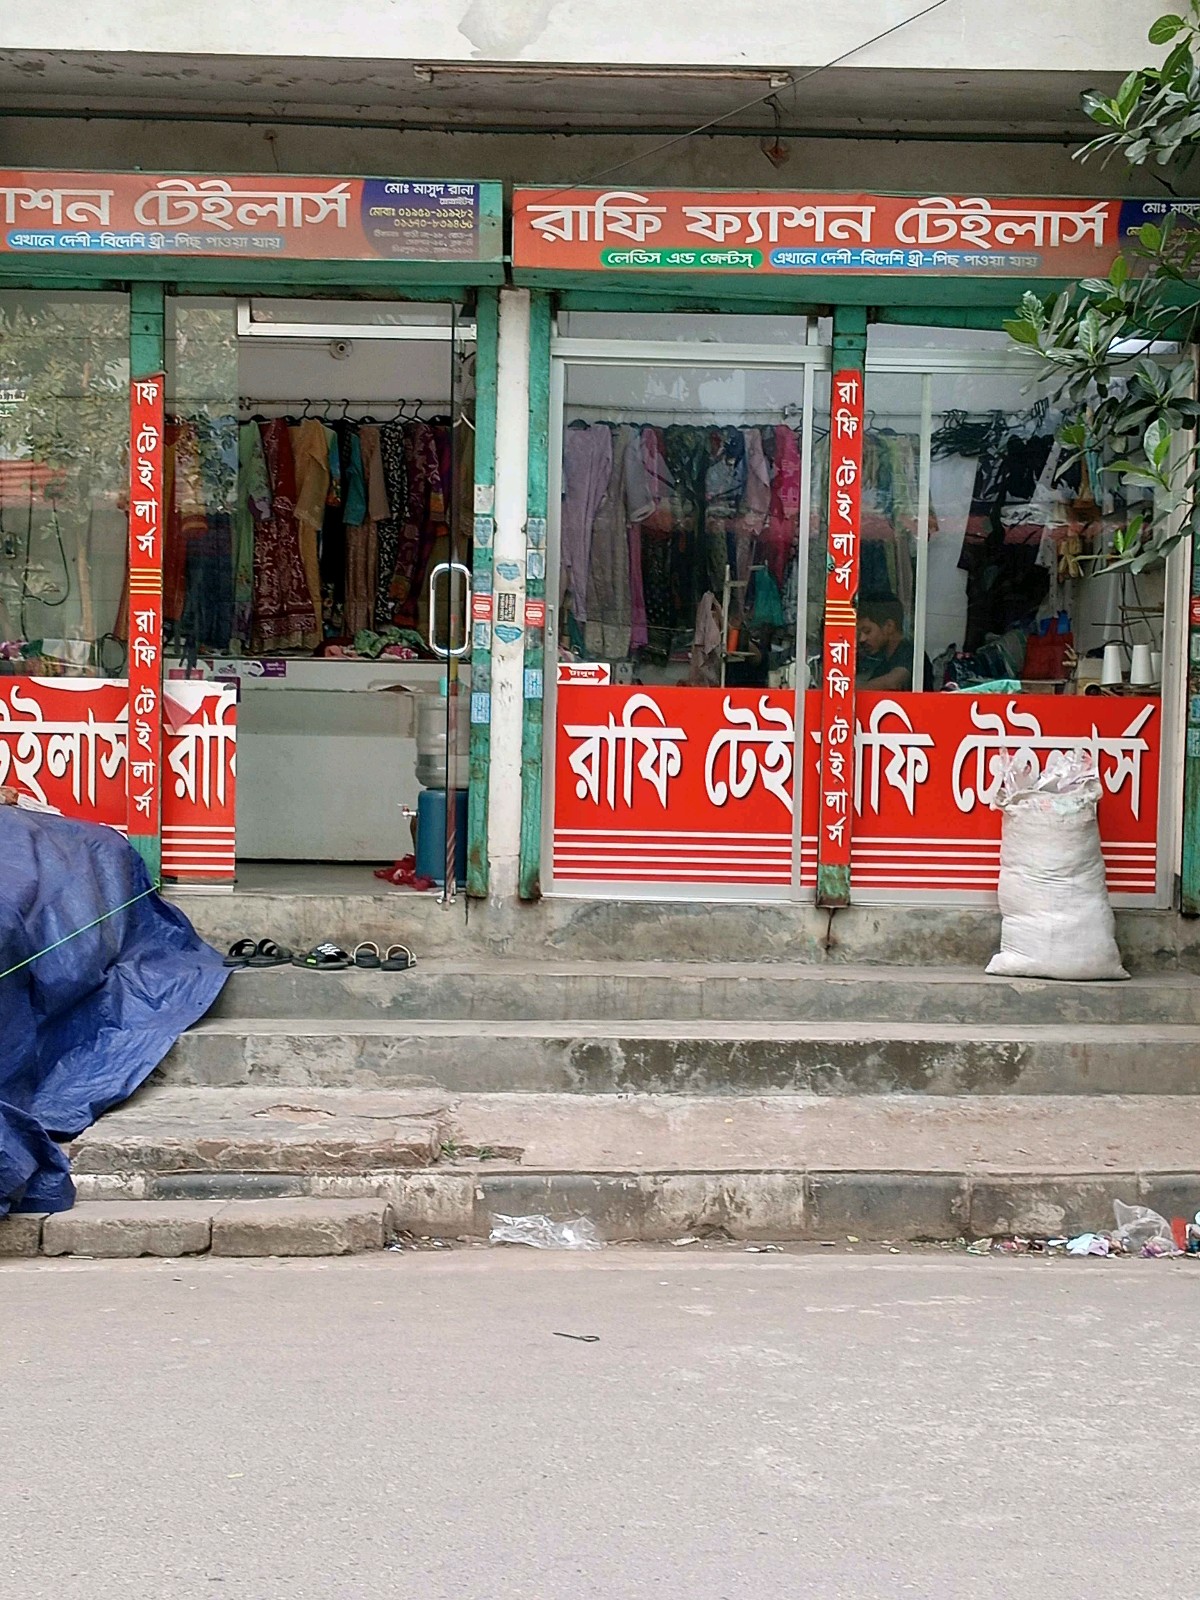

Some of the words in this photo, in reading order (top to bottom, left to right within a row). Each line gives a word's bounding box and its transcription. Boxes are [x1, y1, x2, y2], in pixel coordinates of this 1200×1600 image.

[384, 183, 410, 195] মোঃ
[413, 183, 445, 198] মাসুদ
[447, 184, 475, 196] রানা
[133, 178, 351, 231] টেইলার্স
[1142, 202, 1167, 213] মোঃ
[526, 191, 667, 242] রাফি
[682, 205, 876, 243] ফ্যাশন
[894, 196, 1110, 249] টেইলার্স
[11, 233, 55, 247] এখানে
[207, 236, 248, 249] পাওয়া
[252, 237, 281, 249] যায়
[607, 248, 661, 265] লেডিস
[773, 251, 817, 265] এখানে
[964, 254, 1004, 268] পাওয়া
[1010, 255, 1038, 269] যায়
[563, 693, 688, 811] রাফি
